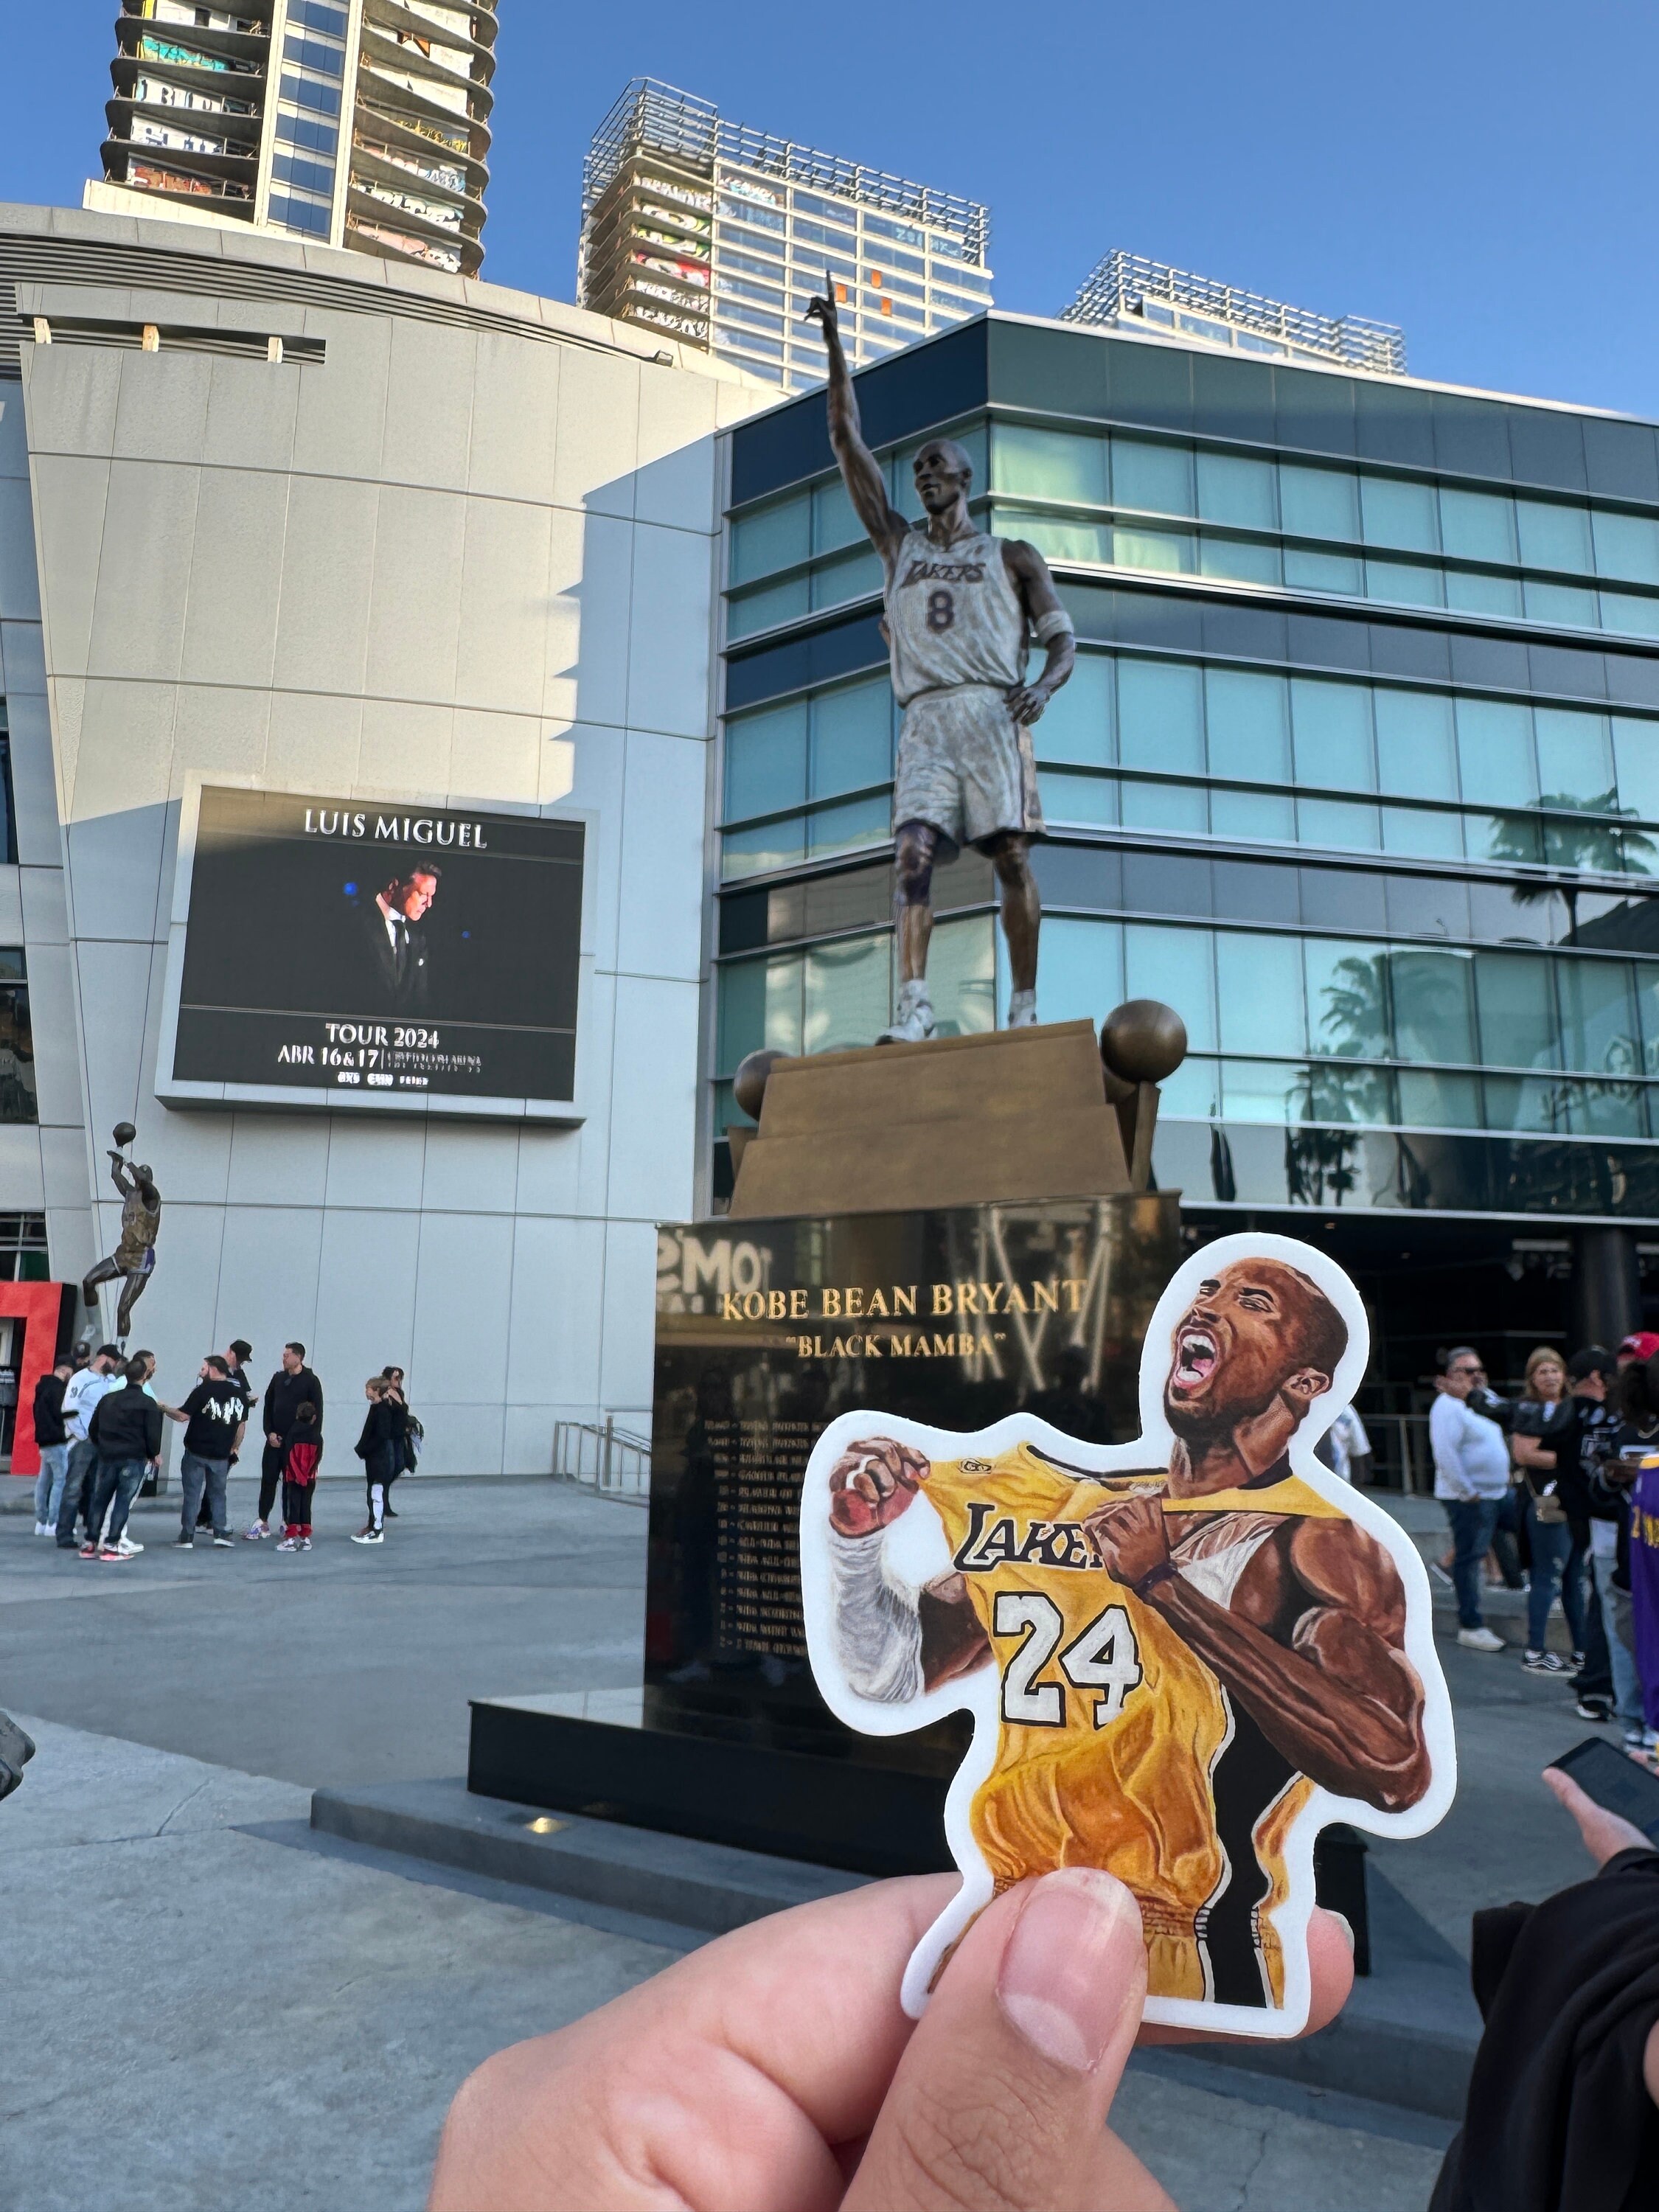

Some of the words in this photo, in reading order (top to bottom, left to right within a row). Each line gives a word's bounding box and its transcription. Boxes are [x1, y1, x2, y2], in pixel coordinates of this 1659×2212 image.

[928, 590, 954, 632] 8
[305, 809, 366, 837] LUIS
[375, 815, 487, 849] MIGUEL
[277, 1044, 315, 1065] ABR
[325, 1023, 389, 1046] TOUR
[394, 1027, 439, 1049] 2024
[723, 1288, 810, 1320] KOBE
[821, 1285, 917, 1318] BEAN
[931, 1279, 1088, 1316] BRYANT
[953, 1502, 1105, 1572] LAKE
[994, 1590, 1144, 1731] 24
